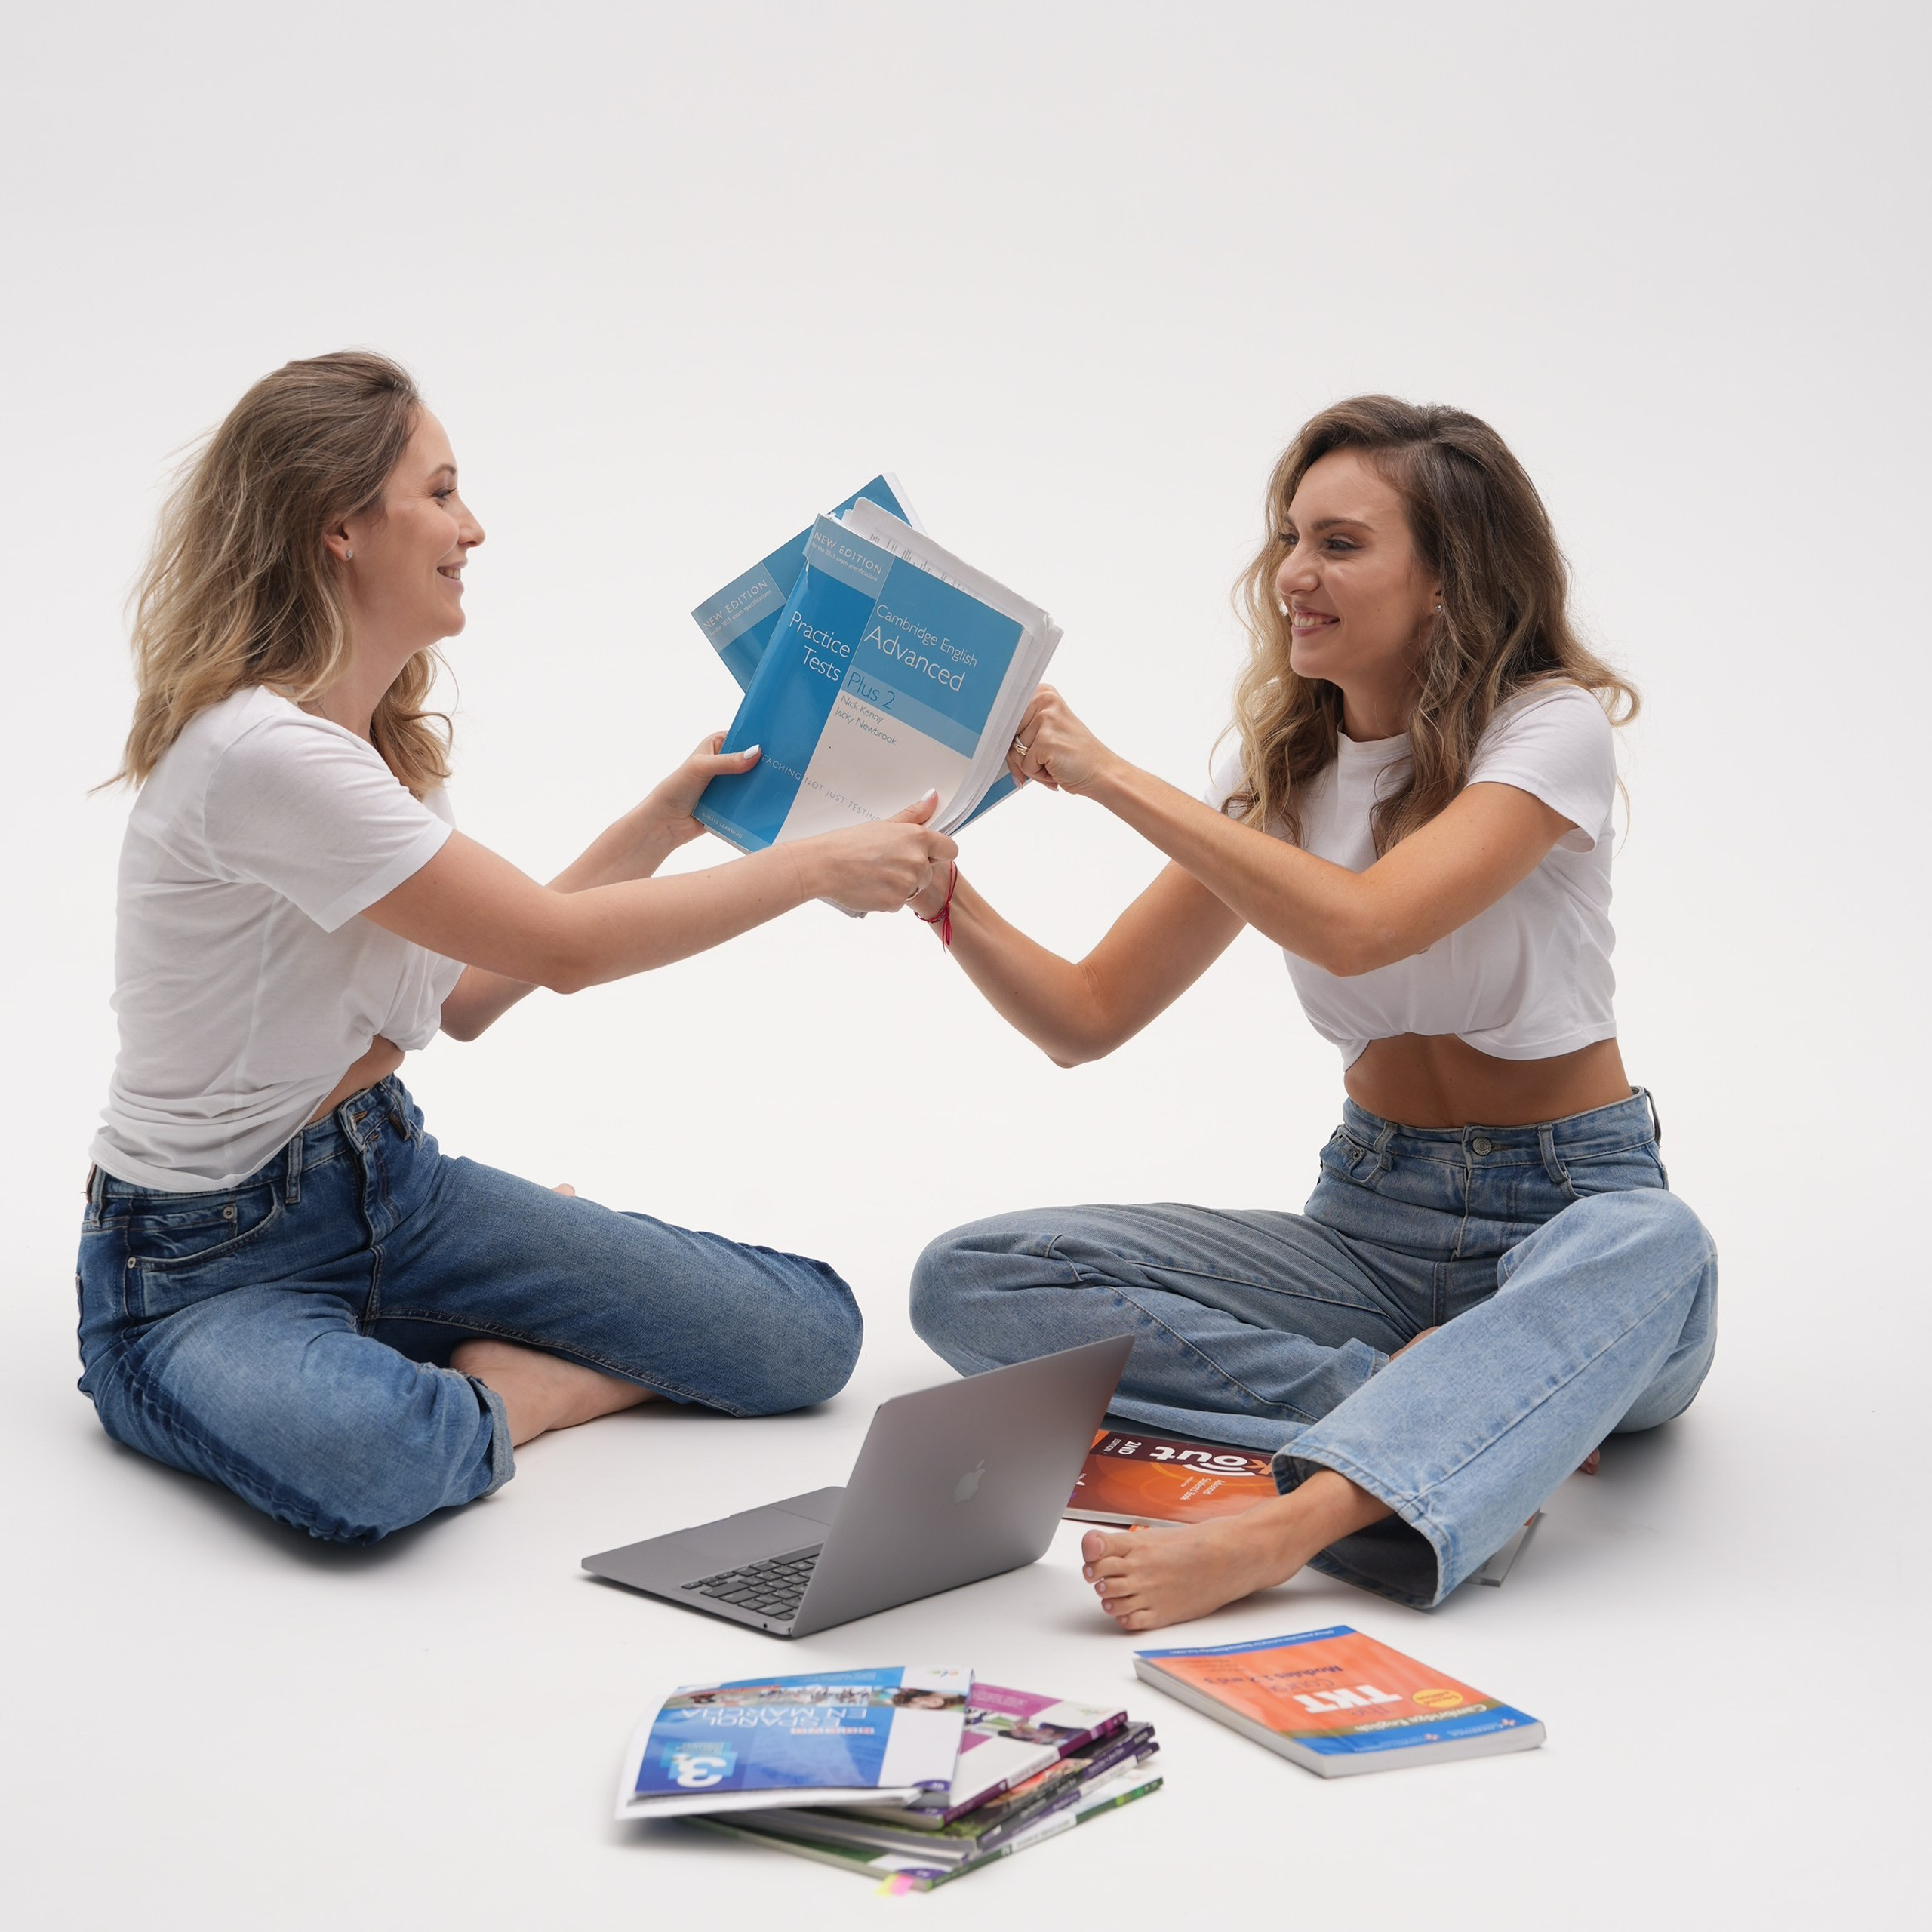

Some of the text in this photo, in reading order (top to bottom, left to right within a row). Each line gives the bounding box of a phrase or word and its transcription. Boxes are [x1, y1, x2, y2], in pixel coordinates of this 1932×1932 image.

[814, 531, 837, 548] NEW
[838, 546, 883, 574] EDITION
[817, 544, 826, 553] the
[825, 549, 836, 559] 2015
[835, 556, 848, 566] exam
[848, 563, 878, 582] specifications
[703, 580, 768, 629] NEW EDITION
[721, 617, 732, 627] 2015
[732, 609, 744, 620] exam
[743, 590, 772, 612] specifications
[789, 611, 851, 658] Practice
[876, 604, 978, 668] Cambridge English
[803, 645, 841, 681] Tests
[864, 626, 966, 692] Advanced
[847, 671, 896, 710] Plus 2
[834, 707, 897, 746] Jacky Newbrook
[840, 695, 884, 724] Nick Kenny
[761, 754, 801, 780] EACHING
[804, 777, 824, 792] NOT
[826, 789, 846, 804] JUST
[702, 812, 743, 838] ALWAYS LEARNING
[1118, 1441, 1142, 1455] 2ND
[1275, 1665, 1343, 1678] Modules
[681, 1708, 867, 1718] EN MARCHA
[1292, 1684, 1403, 1714] TKT
[709, 1717, 841, 1728] ESPAÑOL
[1354, 1703, 1487, 1732] Cambridge English
[677, 1756, 727, 1788] 3
